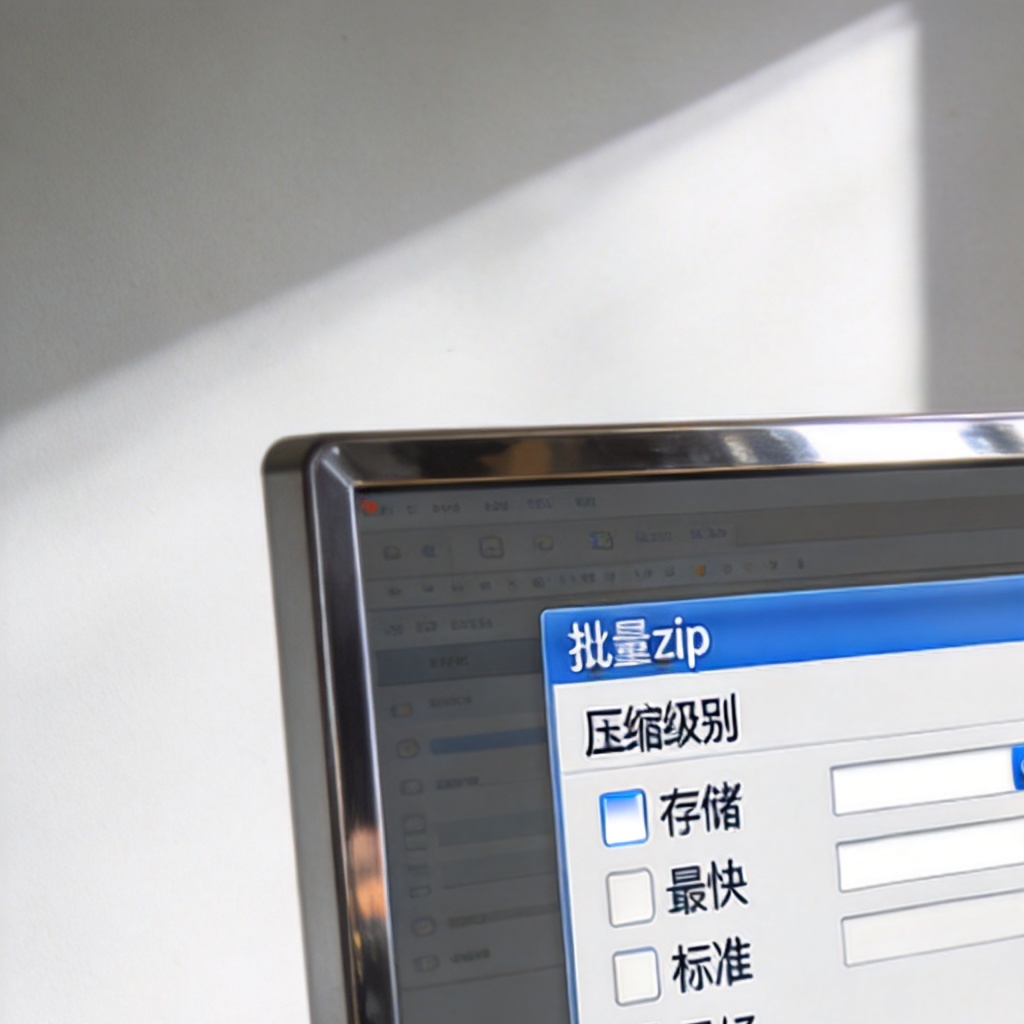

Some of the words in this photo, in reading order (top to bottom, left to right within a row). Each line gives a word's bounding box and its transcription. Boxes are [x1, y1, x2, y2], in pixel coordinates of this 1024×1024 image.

[568, 617, 711, 673] 批量zip
[585, 693, 739, 757] 压缩级别
[660, 781, 742, 838] 存储
[666, 858, 749, 915] 最快
[671, 936, 753, 994] 标准
